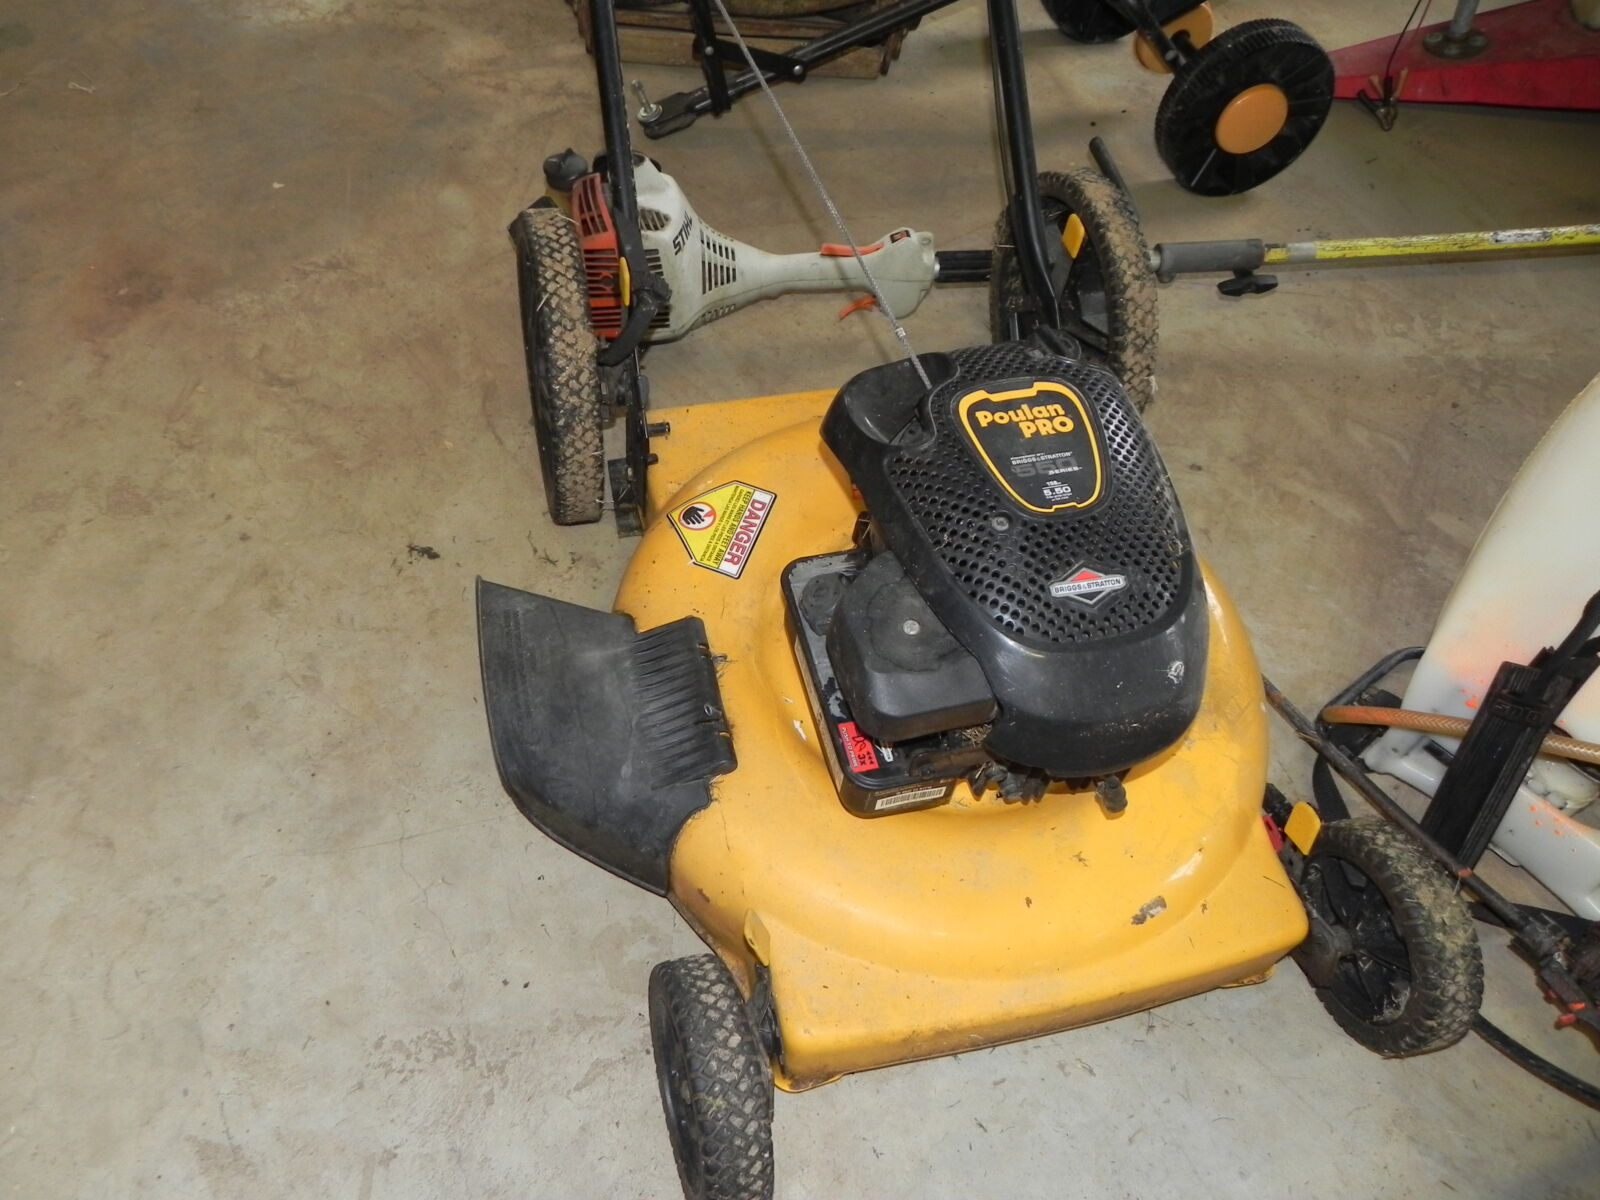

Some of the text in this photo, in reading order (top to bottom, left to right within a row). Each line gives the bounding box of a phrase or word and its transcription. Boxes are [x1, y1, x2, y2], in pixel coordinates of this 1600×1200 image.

[672, 210, 693, 256] STIHL
[975, 403, 1065, 427] Poulan
[1019, 416, 1075, 438] PRO
[1043, 486, 1071, 496] 5.50
[712, 491, 752, 565] KEEP HANDS AND FEET AWAY
[723, 498, 768, 566] DANGER
